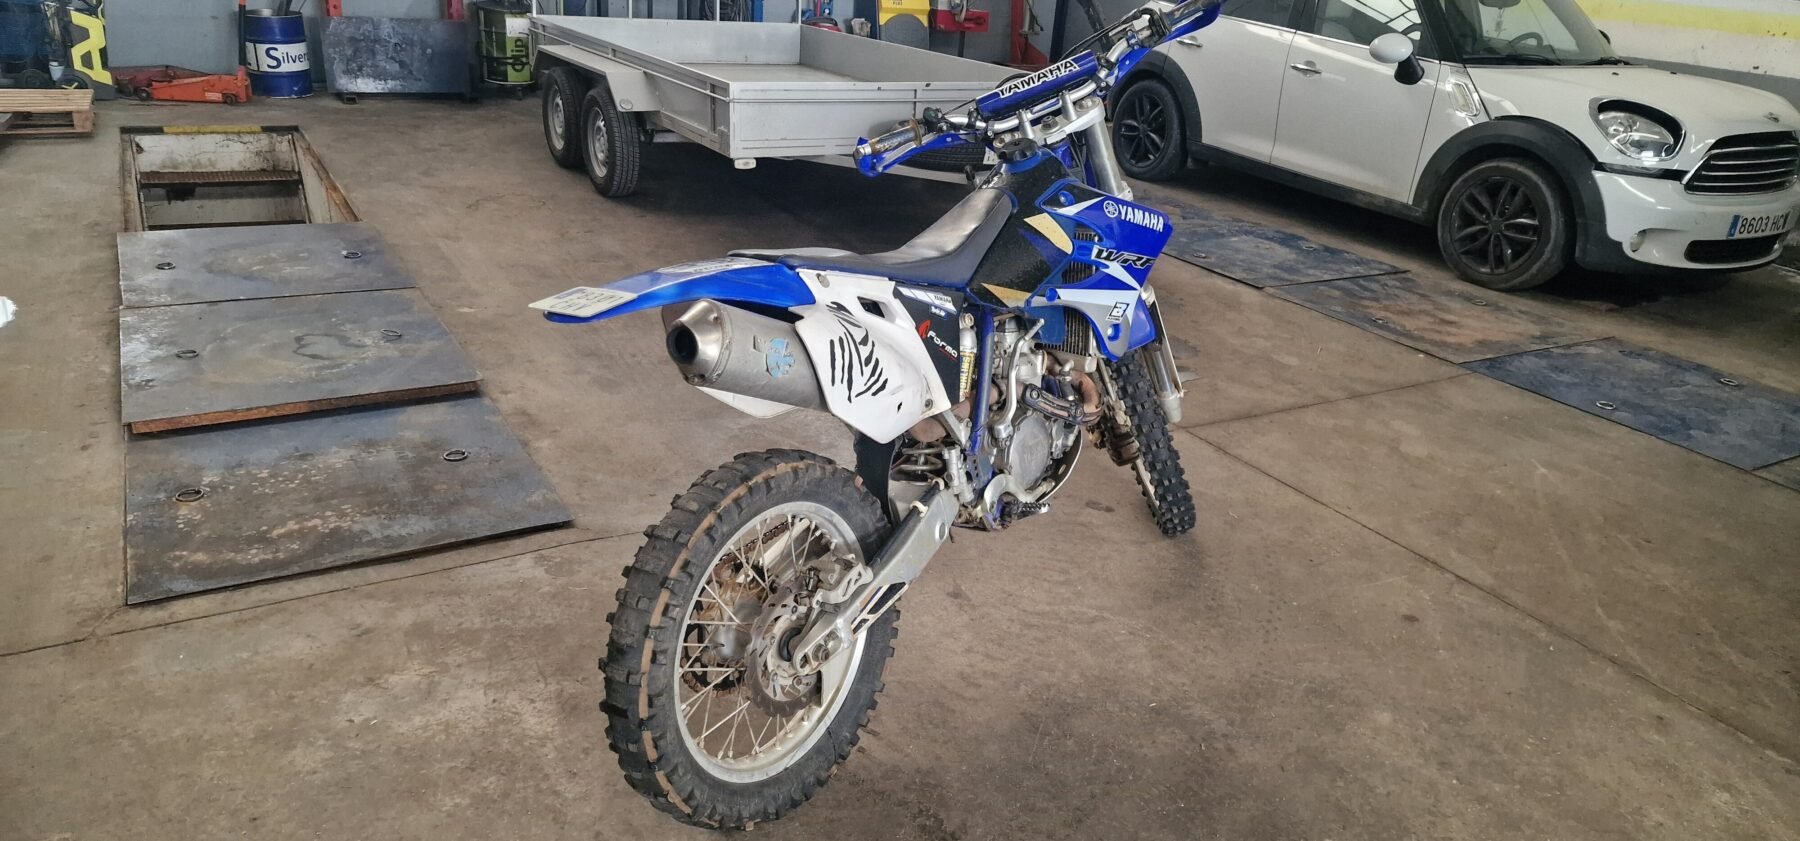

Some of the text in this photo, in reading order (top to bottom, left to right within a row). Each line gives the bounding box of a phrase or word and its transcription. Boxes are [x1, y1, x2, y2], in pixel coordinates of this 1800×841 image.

[999, 60, 1078, 97] YAMAHA
[1119, 204, 1164, 232] YAMAHA
[1739, 215, 1770, 235] 8603
